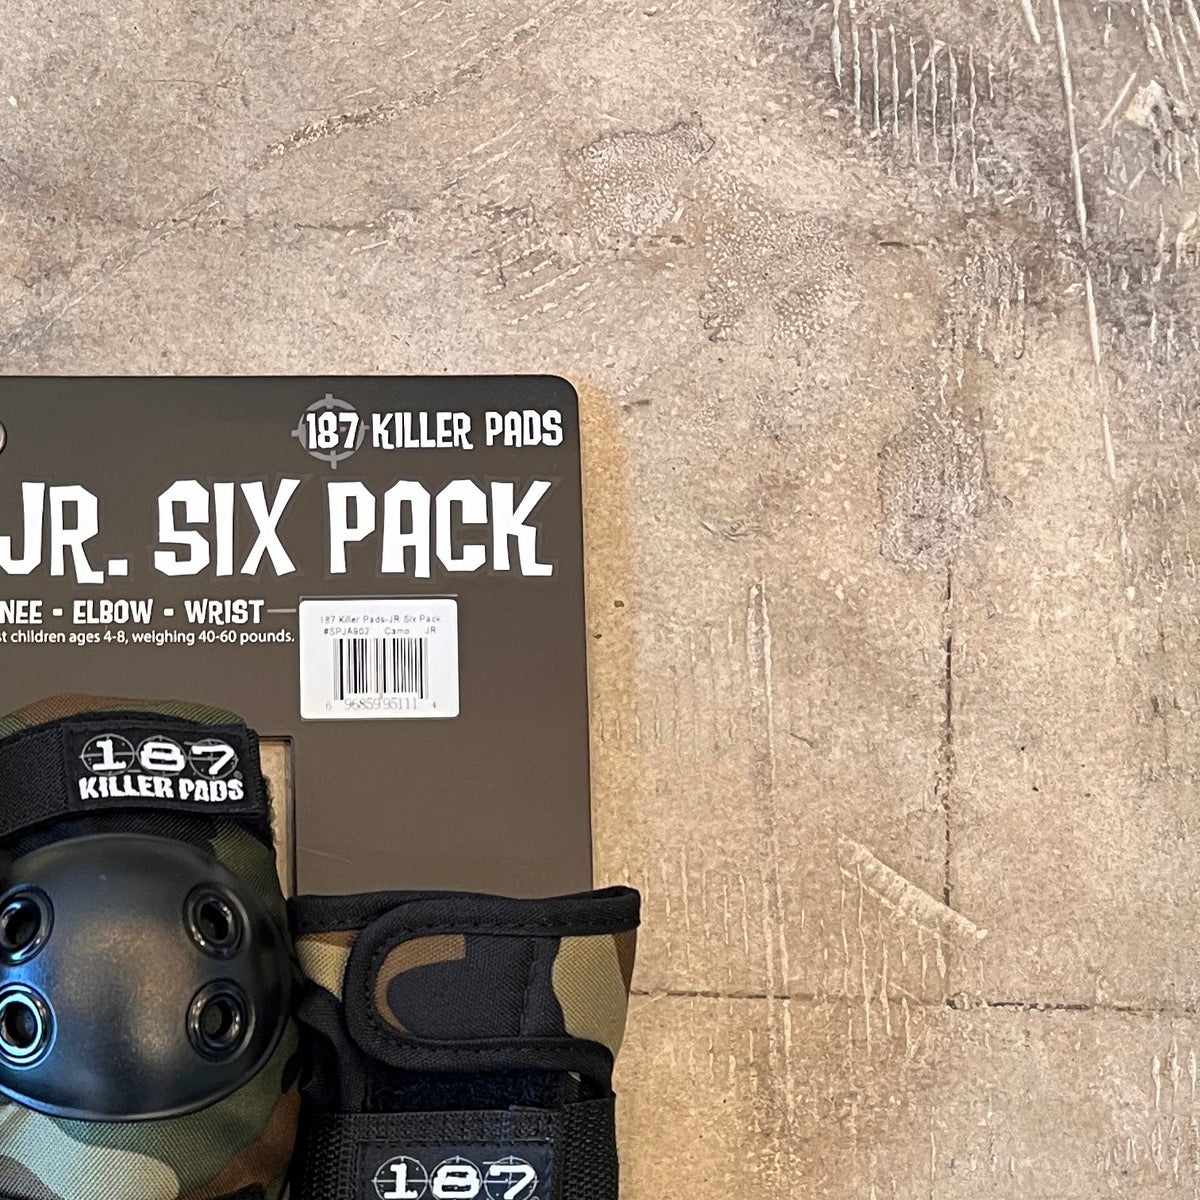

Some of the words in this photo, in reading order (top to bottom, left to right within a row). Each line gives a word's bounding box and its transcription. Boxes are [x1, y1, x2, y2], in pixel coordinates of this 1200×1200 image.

[306, 411, 360, 449] 187
[372, 411, 474, 449] KILLER
[485, 409, 563, 447] PADS
[154, 479, 301, 576] SIX
[328, 479, 553, 578] PACK
[72, 599, 153, 625] ELBOW
[184, 599, 264, 625] WRIST
[320, 615, 336, 624] 187
[338, 615, 360, 624] Killer
[403, 615, 416, 624] Six
[419, 614, 441, 623] Pack
[10, 630, 66, 643] children
[68, 633, 101, 646] ages
[103, 630, 129, 645] 4-8,
[132, 630, 196, 646] weighing
[198, 630, 237, 643] 40-60
[240, 629, 295, 646] pounds.
[384, 627, 410, 635] Camo
[424, 626, 436, 634] JR
[92, 739, 235, 775] 187
[78, 775, 174, 800] KILLER
[178, 777, 244, 802] PADS
[383, 1163, 536, 1200] 187
